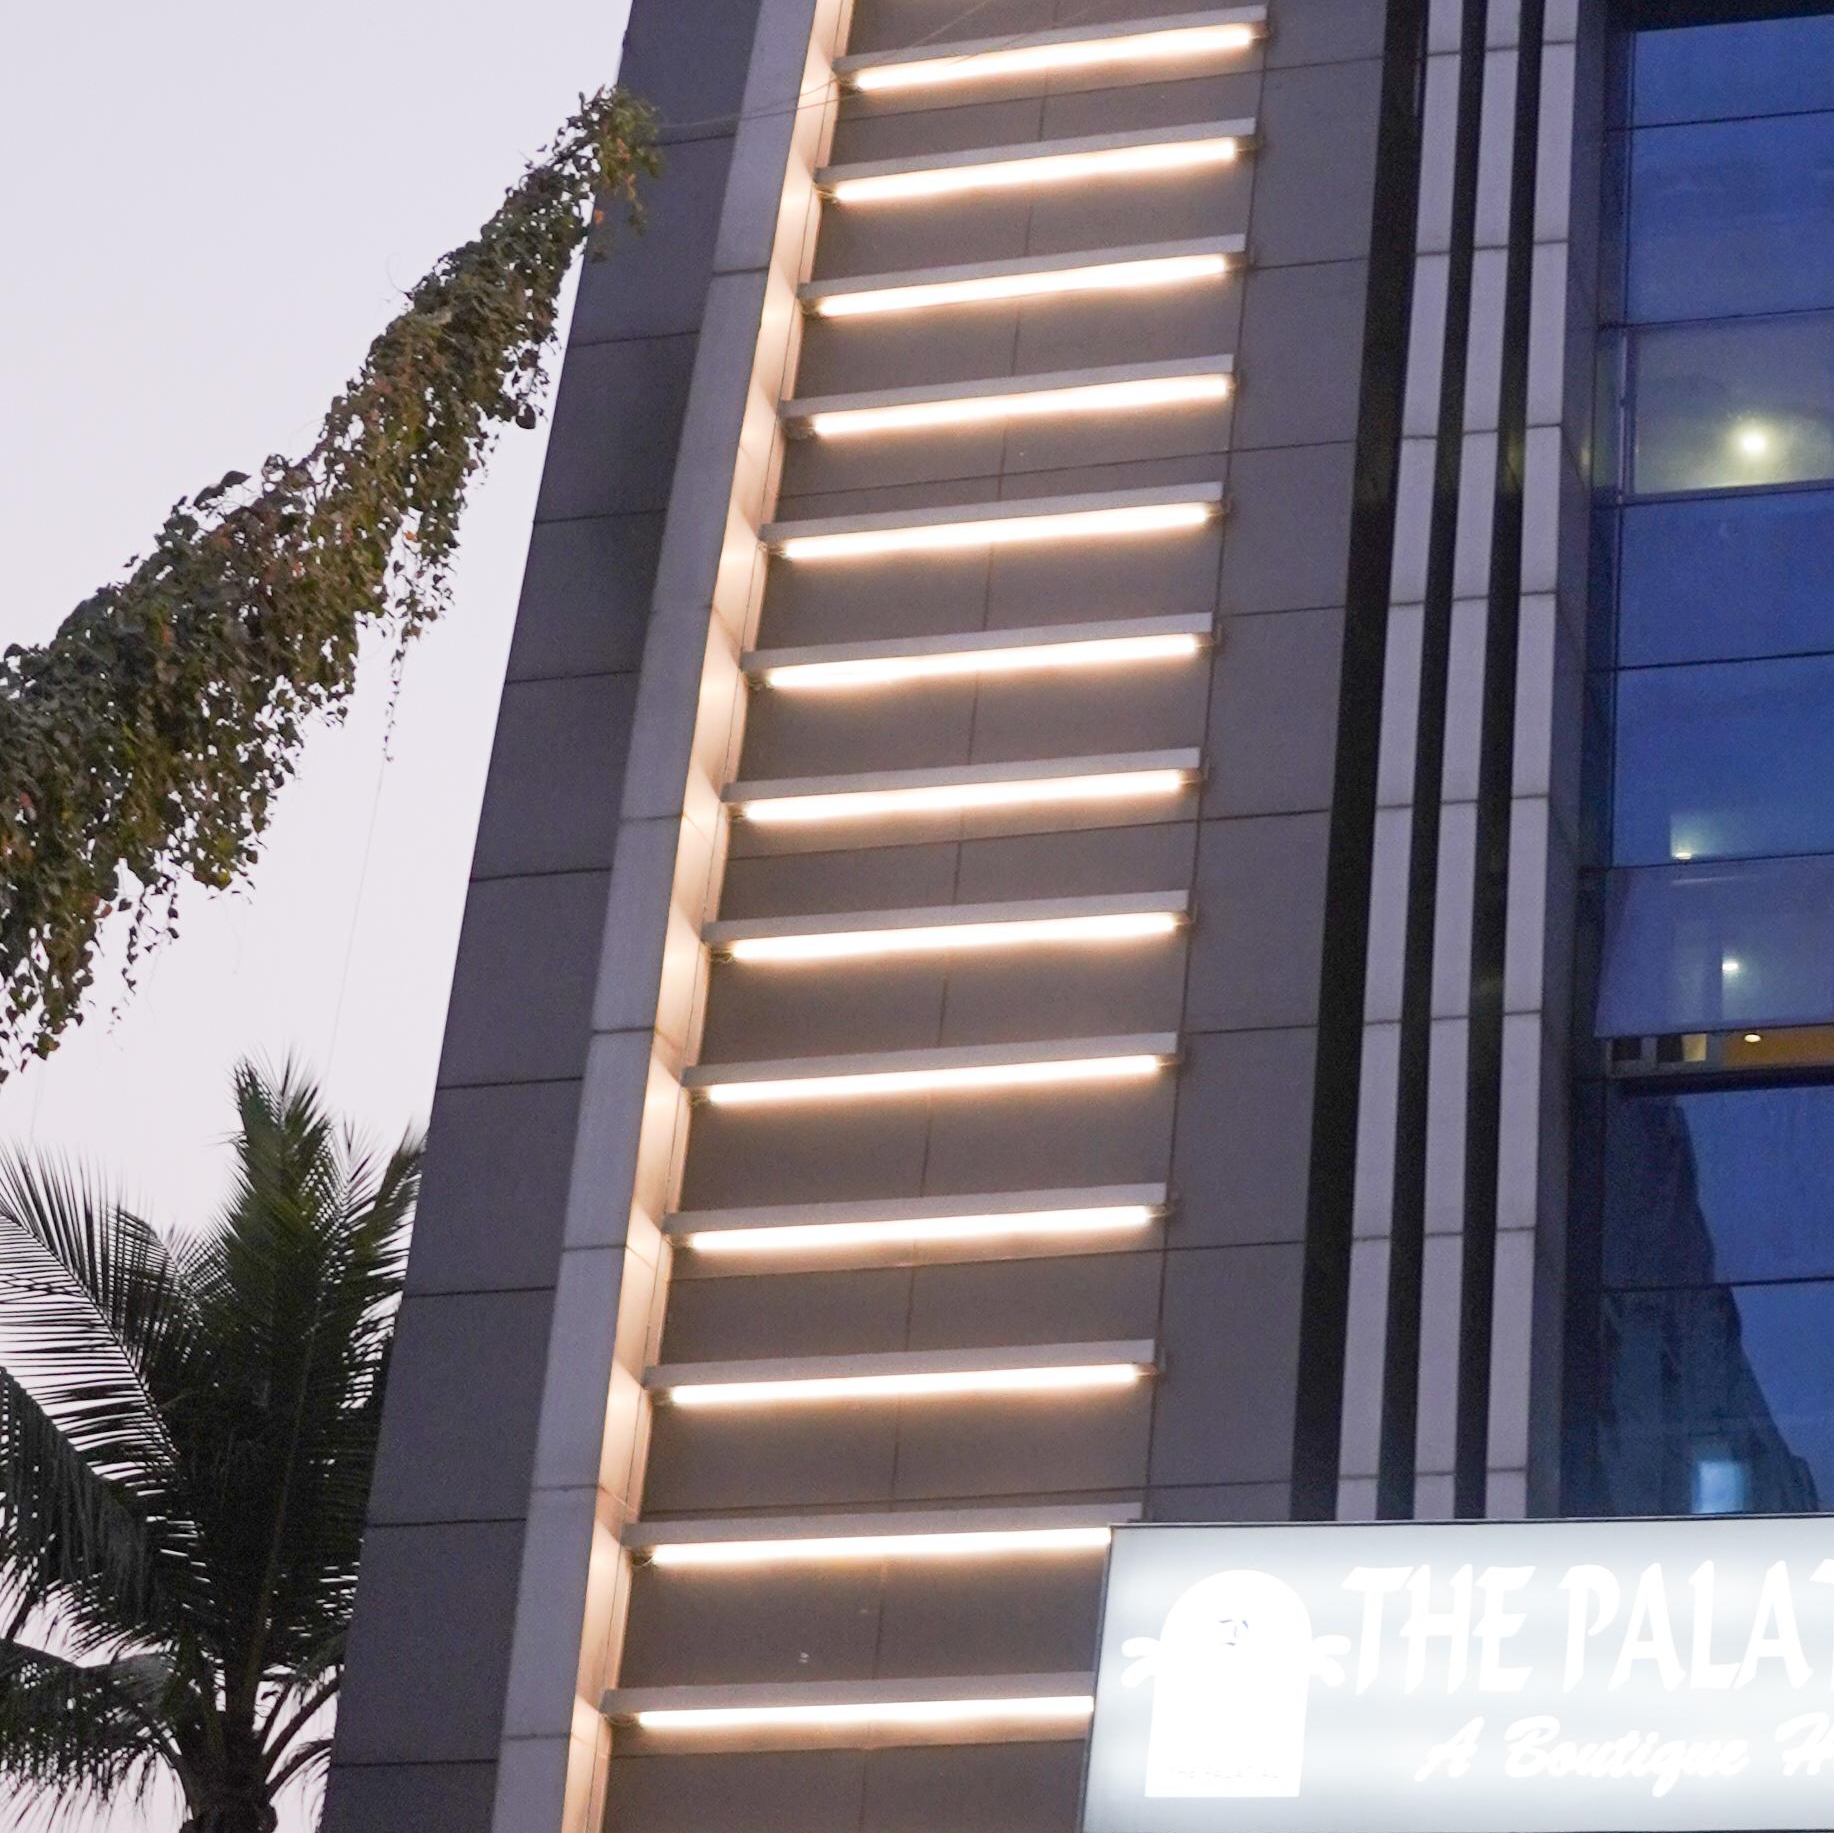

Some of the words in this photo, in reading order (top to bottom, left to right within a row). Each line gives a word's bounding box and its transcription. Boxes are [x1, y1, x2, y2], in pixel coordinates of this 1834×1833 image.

[1341, 1563, 1536, 1696] THE
[1413, 1716, 1485, 1782] A
[1503, 1714, 1748, 1798] Boutique
